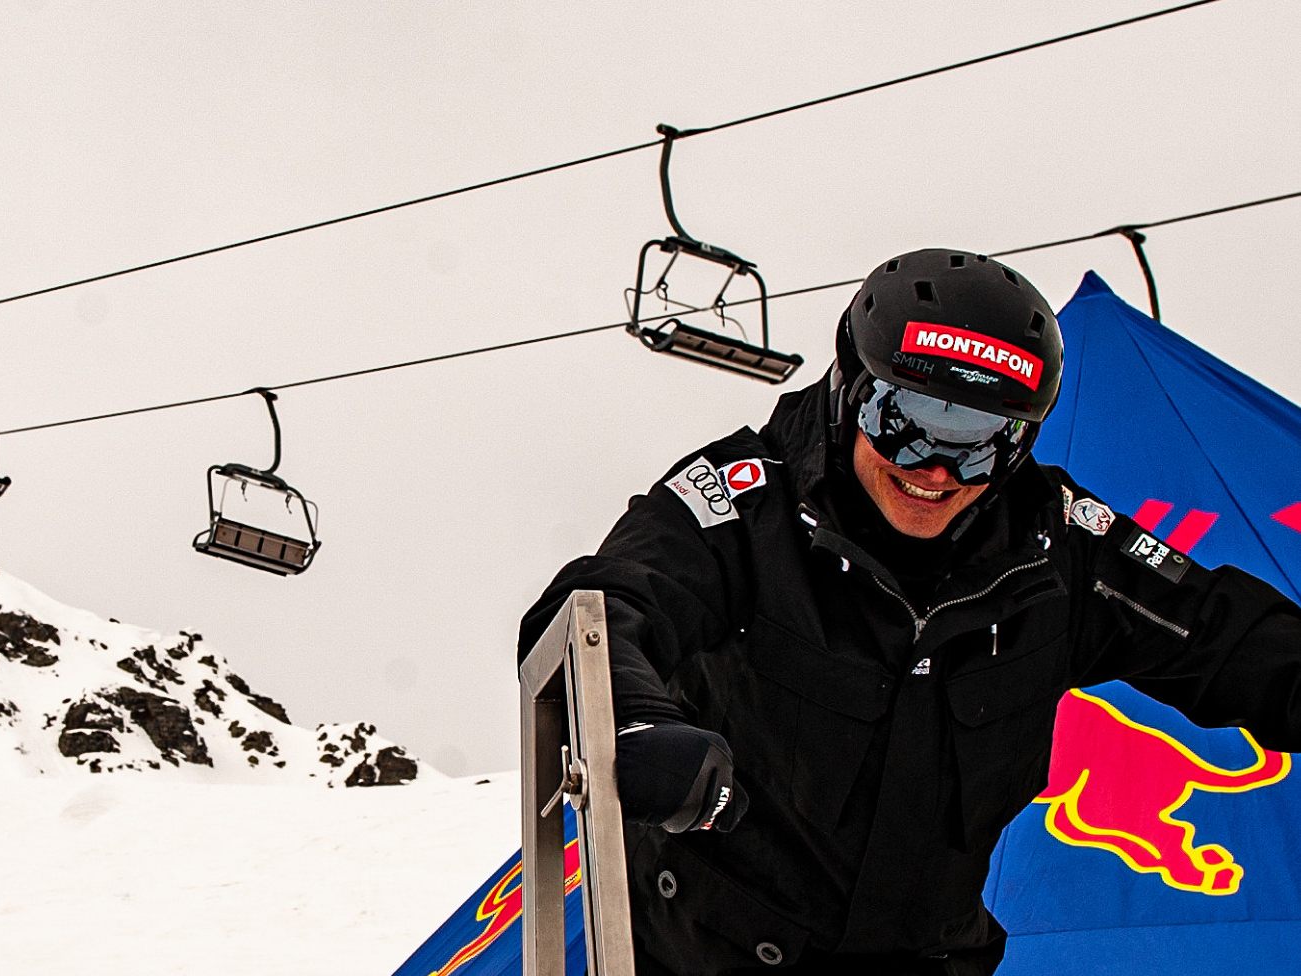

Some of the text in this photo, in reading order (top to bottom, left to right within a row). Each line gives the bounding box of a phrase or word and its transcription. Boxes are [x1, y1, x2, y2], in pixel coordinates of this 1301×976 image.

[891, 351, 935, 375] SMITH
[916, 330, 1034, 378] MONTAFON
[670, 480, 690, 496] Audi
